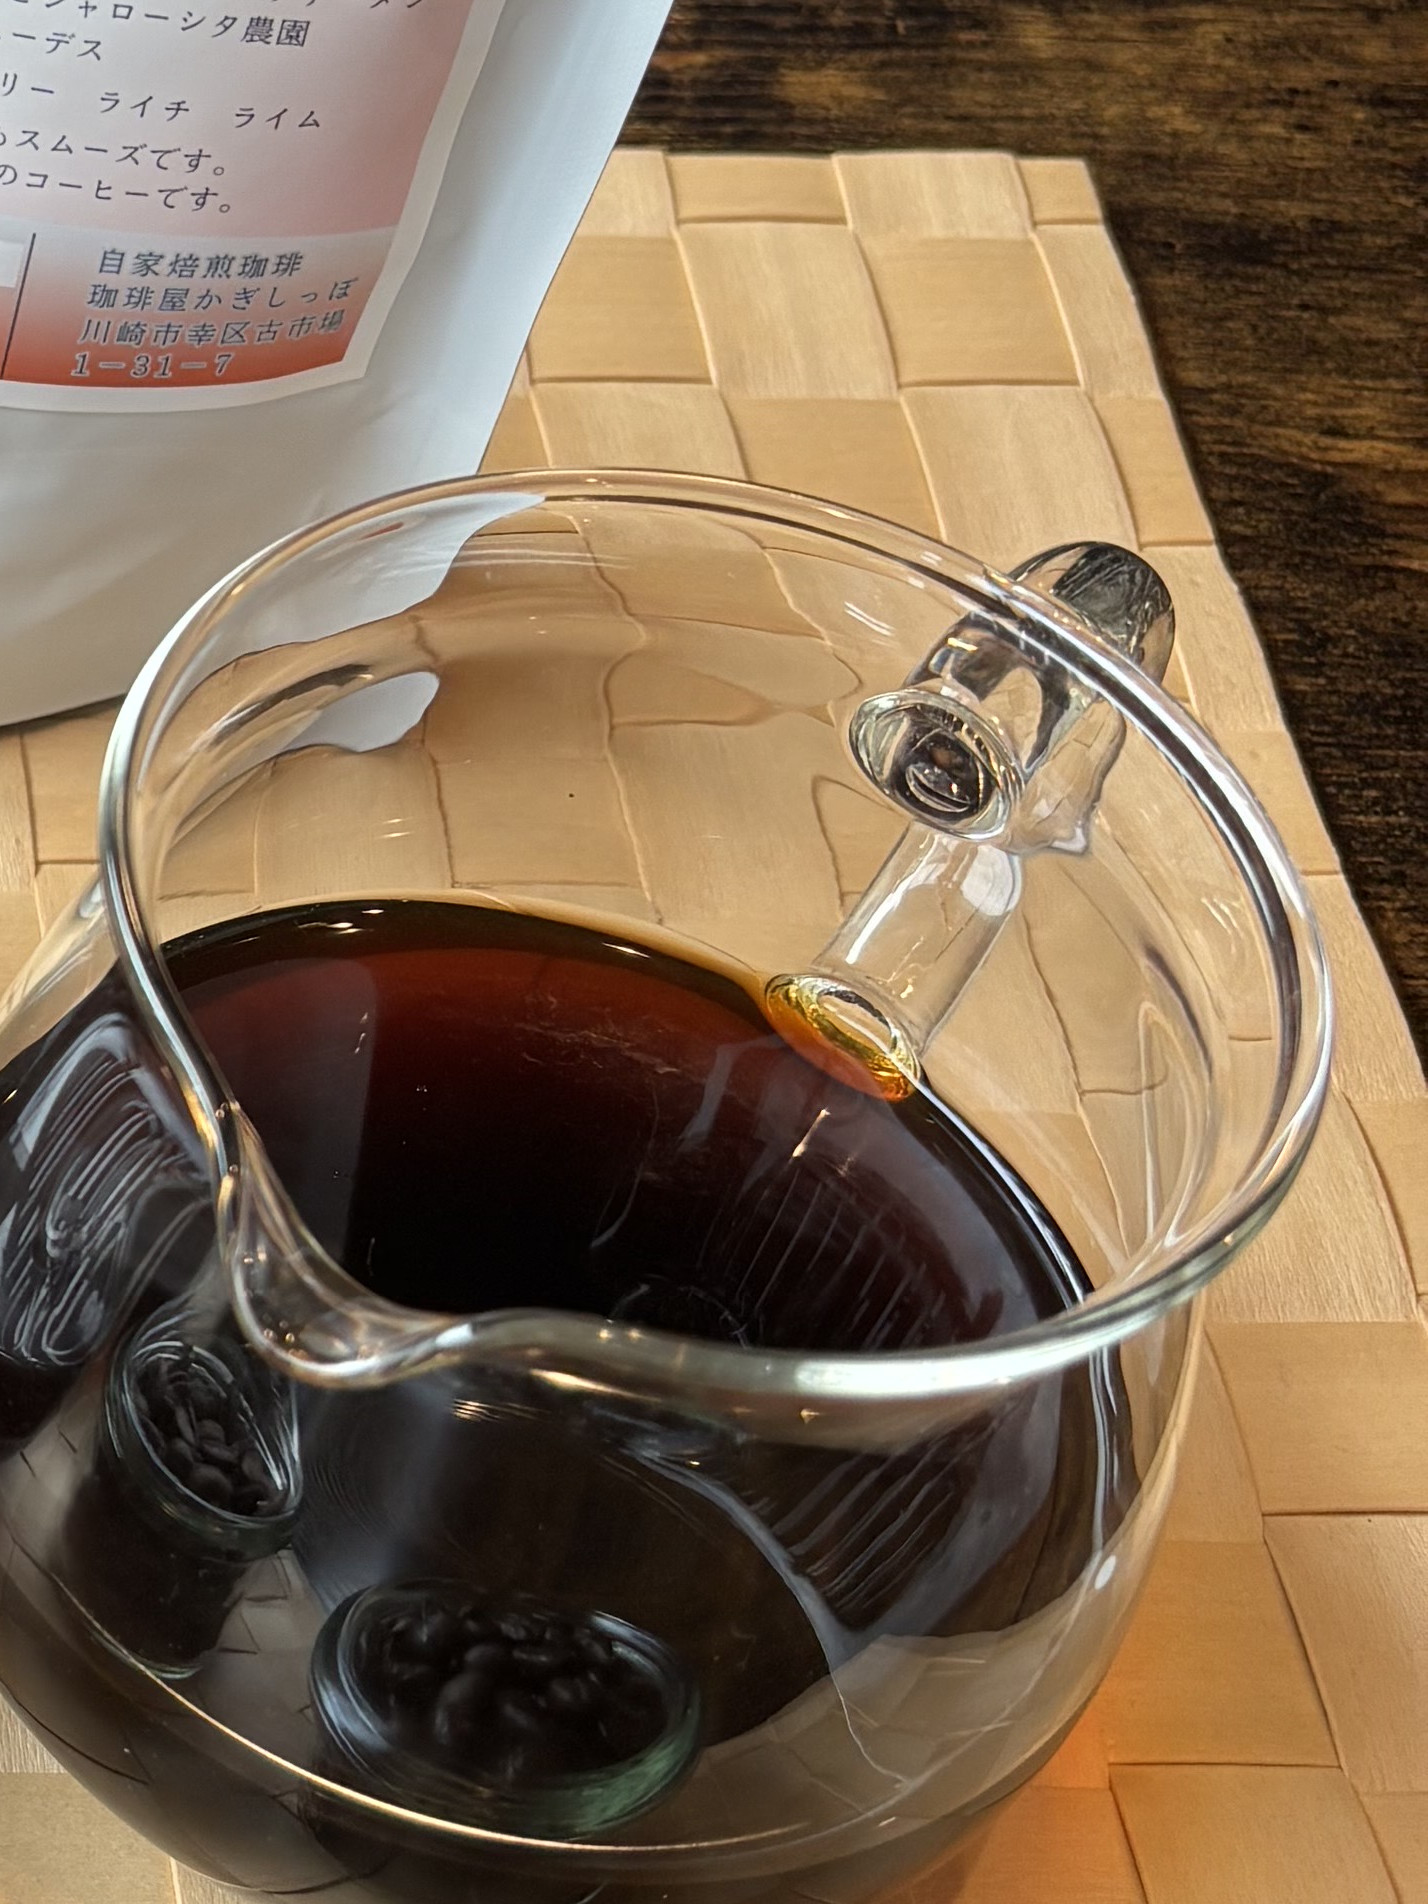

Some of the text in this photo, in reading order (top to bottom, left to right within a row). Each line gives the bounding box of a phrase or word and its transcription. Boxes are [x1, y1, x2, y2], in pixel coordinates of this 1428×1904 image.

[100, 92, 190, 122] ライチ
[234, 106, 322, 131] ライム
[98, 248, 304, 280] 自家焙煎珈琲
[79, 309, 345, 346] 川崎市幸区古市場
